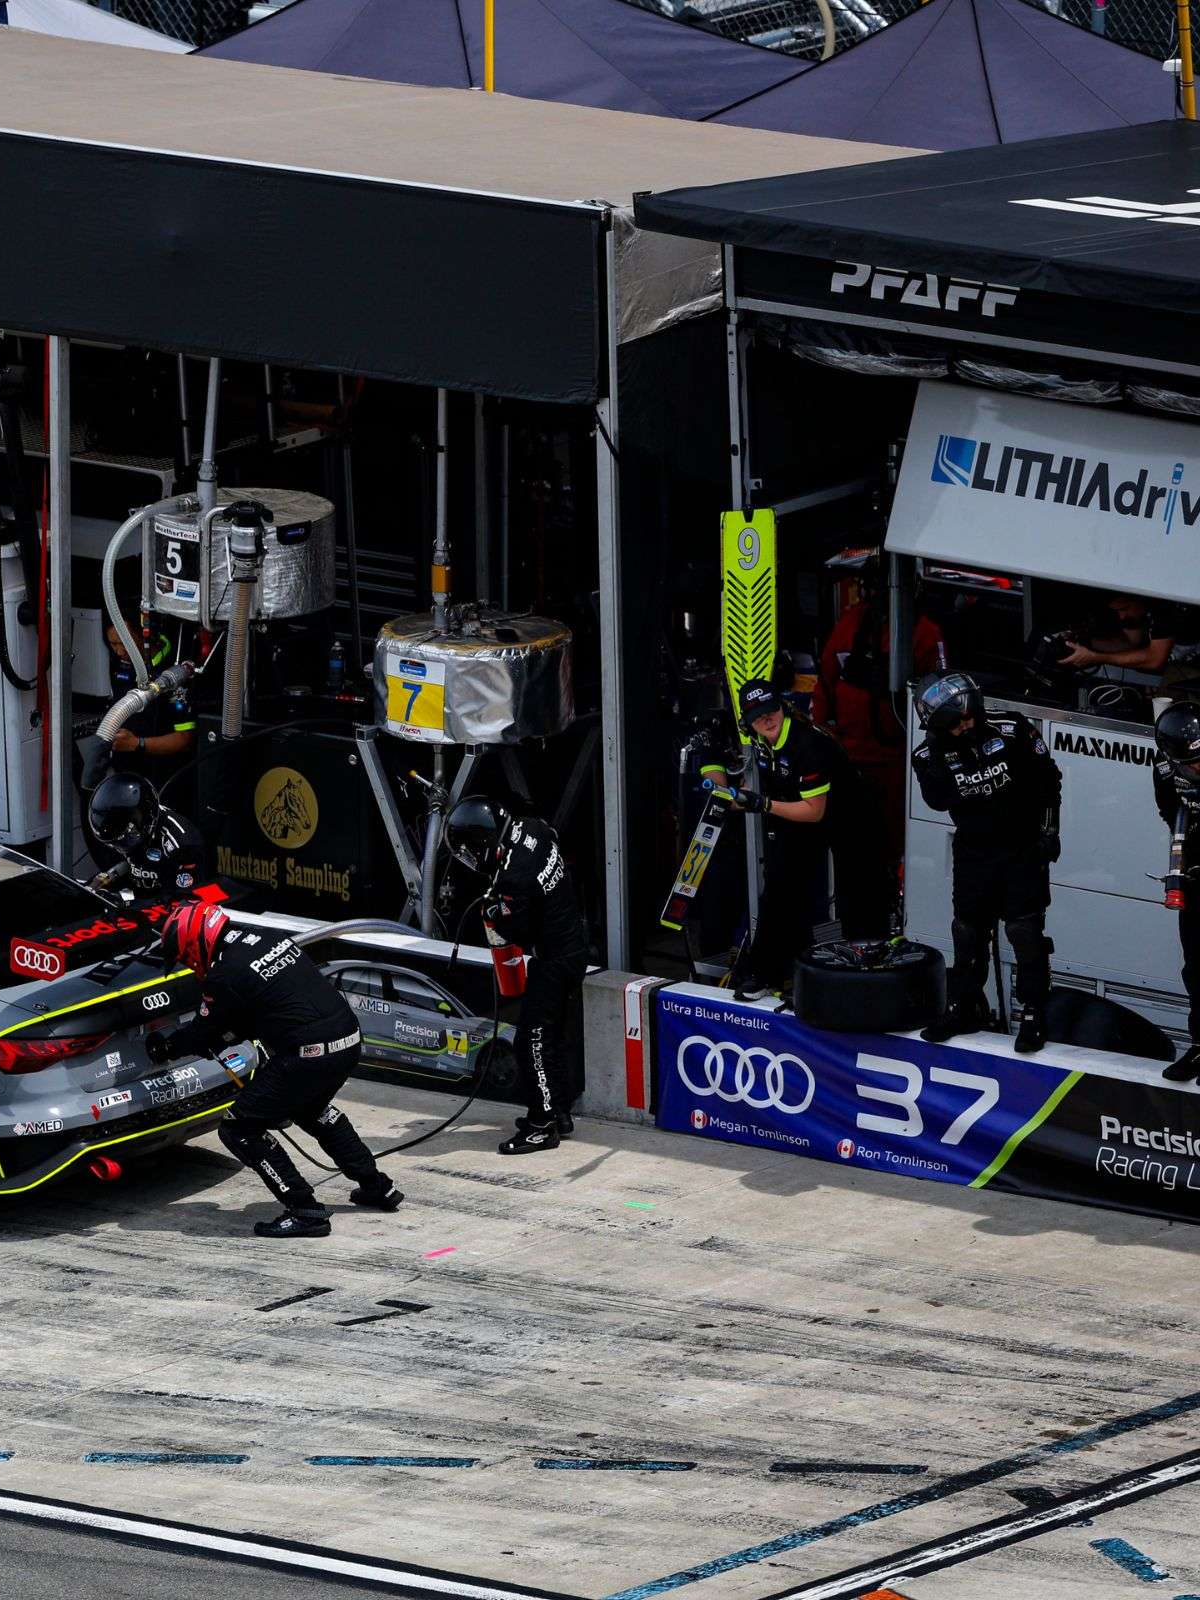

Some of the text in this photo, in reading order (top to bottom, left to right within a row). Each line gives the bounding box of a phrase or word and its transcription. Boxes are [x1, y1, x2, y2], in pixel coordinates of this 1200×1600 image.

[830, 260, 1020, 317] PFAFF
[166, 541, 182, 574] 5
[737, 527, 760, 570] 9
[402, 682, 422, 721] 7
[217, 846, 351, 902] Mustang Sampling
[682, 842, 712, 884] 37
[394, 1020, 440, 1038] Precision
[662, 999, 771, 1032] Ultra Blue Metallic
[453, 1038, 462, 1051] 7
[140, 1066, 199, 1091] Precision
[150, 1077, 205, 1105] Racing LA
[112, 1093, 129, 1101] TCR
[855, 1052, 1000, 1146] 37
[24, 1120, 63, 1134] AMED
[709, 1115, 811, 1149] Megan Tomlinson
[856, 1145, 950, 1174] Ron Tomlinson
[1095, 1146, 1179, 1191] Racing
